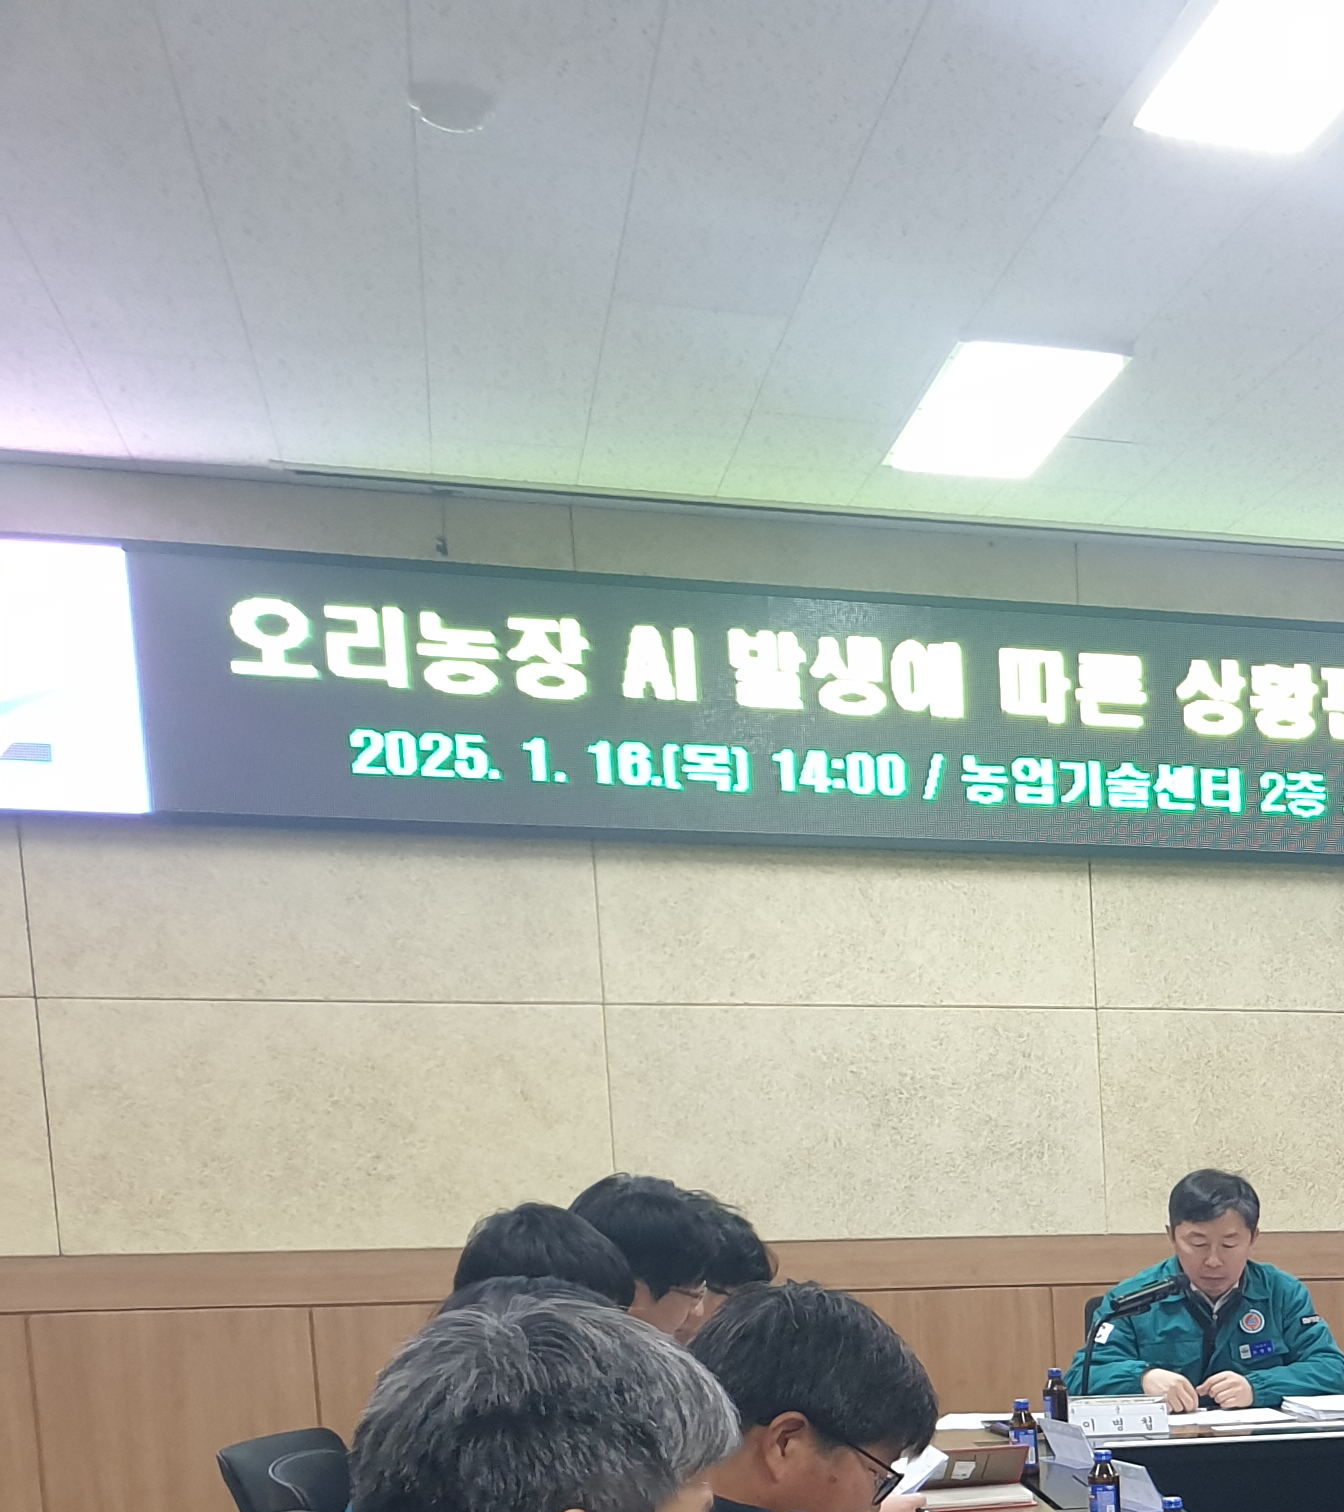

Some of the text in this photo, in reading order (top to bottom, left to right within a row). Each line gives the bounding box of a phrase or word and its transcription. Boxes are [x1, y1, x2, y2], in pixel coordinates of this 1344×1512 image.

[230, 596, 592, 701] 오리농장
[622, 624, 699, 702] AI
[726, 627, 967, 720] 발생에
[998, 647, 1149, 731] 따른
[349, 728, 503, 780] 2025.
[522, 737, 569, 784] 1.
[587, 739, 752, 794] 16.(목)
[771, 748, 909, 797] 14:00
[922, 752, 947, 801] /
[960, 754, 1244, 814] 농업기술센터
[1259, 771, 1327, 819] 2층
